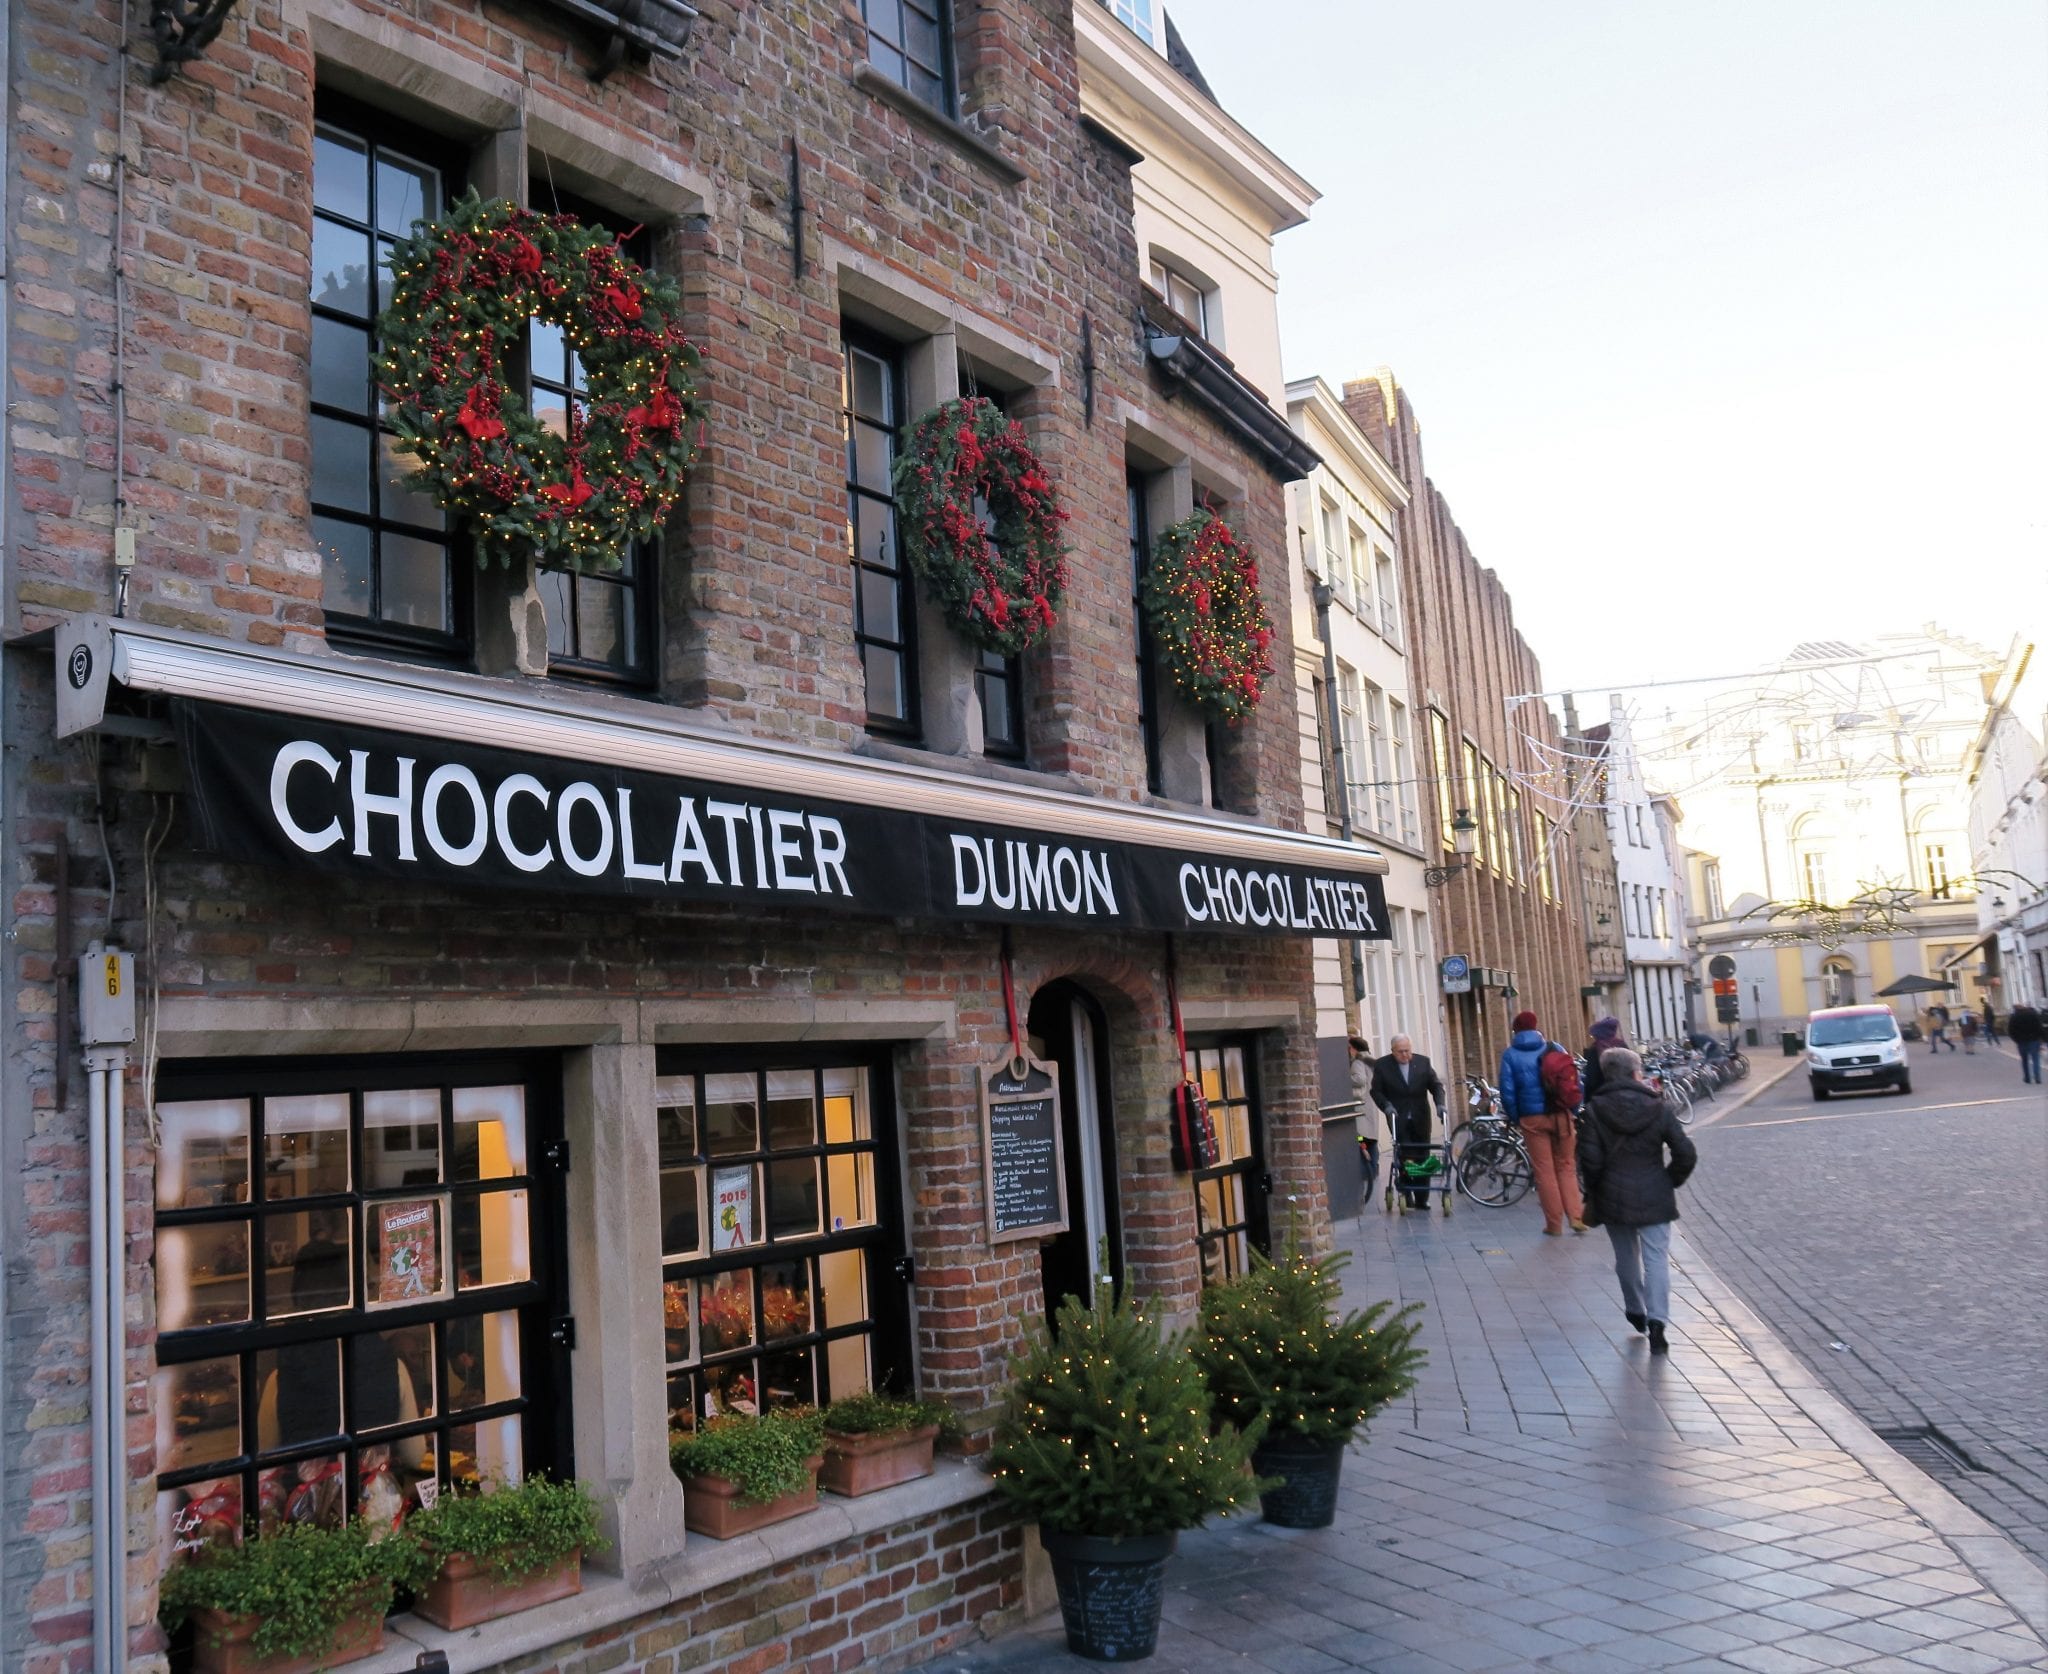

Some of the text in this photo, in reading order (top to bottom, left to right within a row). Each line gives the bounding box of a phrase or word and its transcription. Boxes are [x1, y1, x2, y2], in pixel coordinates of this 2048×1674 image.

[270, 740, 854, 898] CHOCOLATIER
[950, 833, 1120, 915] DUMON
[1179, 862, 1376, 932] CHOCOLATIER
[396, 1210, 427, 1227] Routard
[720, 1190, 747, 1204] 2015
